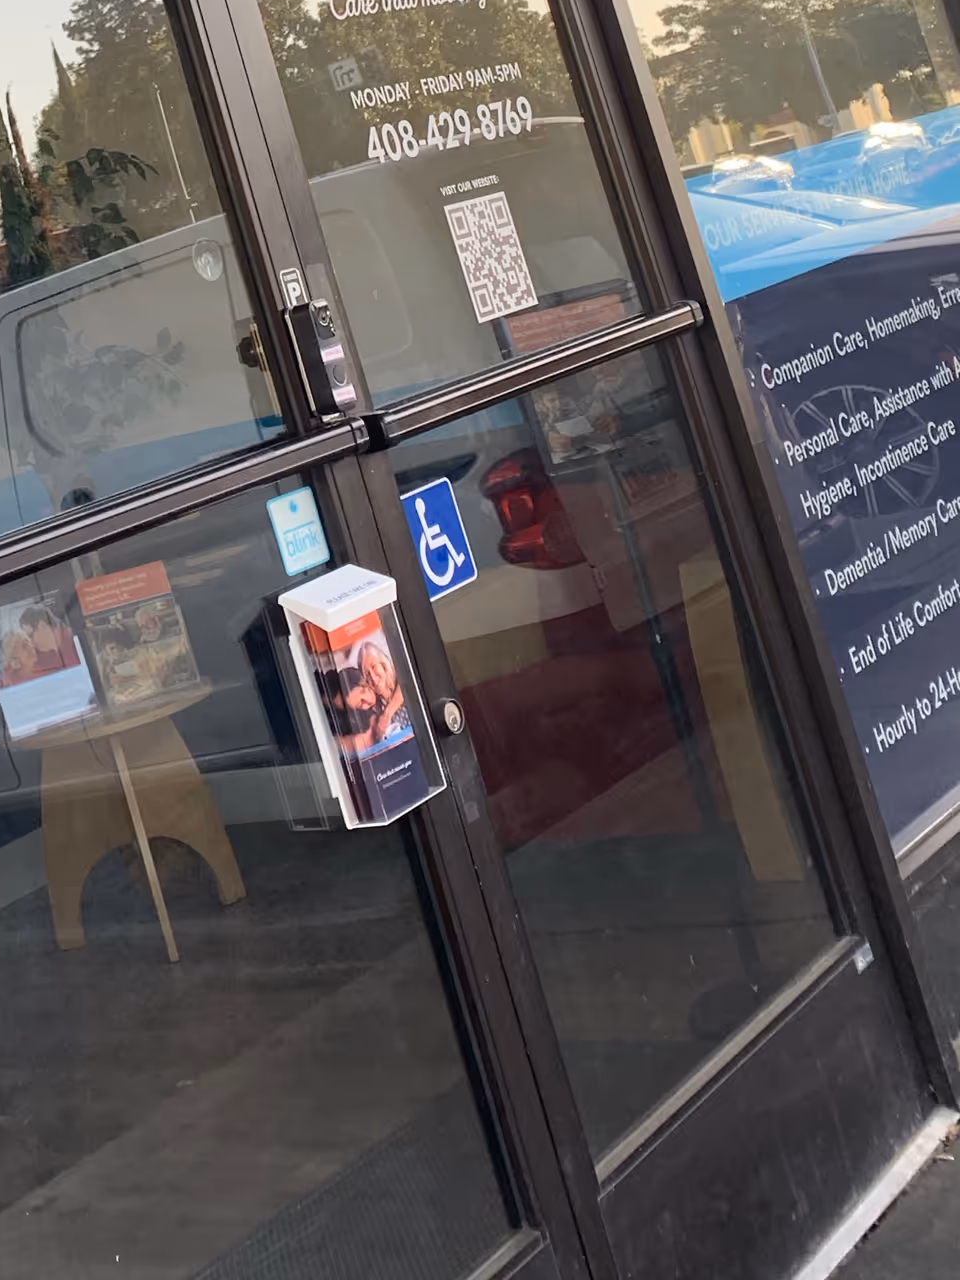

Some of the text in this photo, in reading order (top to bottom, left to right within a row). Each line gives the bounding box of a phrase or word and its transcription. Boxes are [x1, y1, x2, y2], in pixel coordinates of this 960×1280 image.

[350, 81, 411, 110] MONDAY
[420, 72, 465, 97] FRIDAY
[465, 61, 523, 88] 9AM-5PM
[367, 95, 533, 164] 408-429-8769
[439, 184, 457, 197] VISIT
[457, 180, 473, 193] OUR
[703, 214, 743, 251] OUR
[761, 343, 835, 390] Companion
[833, 332, 869, 357] Care,
[865, 296, 941, 342] Homemaking,
[784, 417, 841, 467] Personal
[838, 412, 874, 439] Care,
[873, 383, 931, 421] Assistance
[930, 361, 955, 391] with
[800, 420, 957, 520] Hygiene, Incontinence Care
[284, 528, 318, 557] blink
[824, 547, 886, 596] Dementia
[888, 512, 939, 554] Memory
[848, 579, 960, 675] End of Life Comfort
[872, 705, 918, 753] Hourly
[916, 693, 933, 716] to
